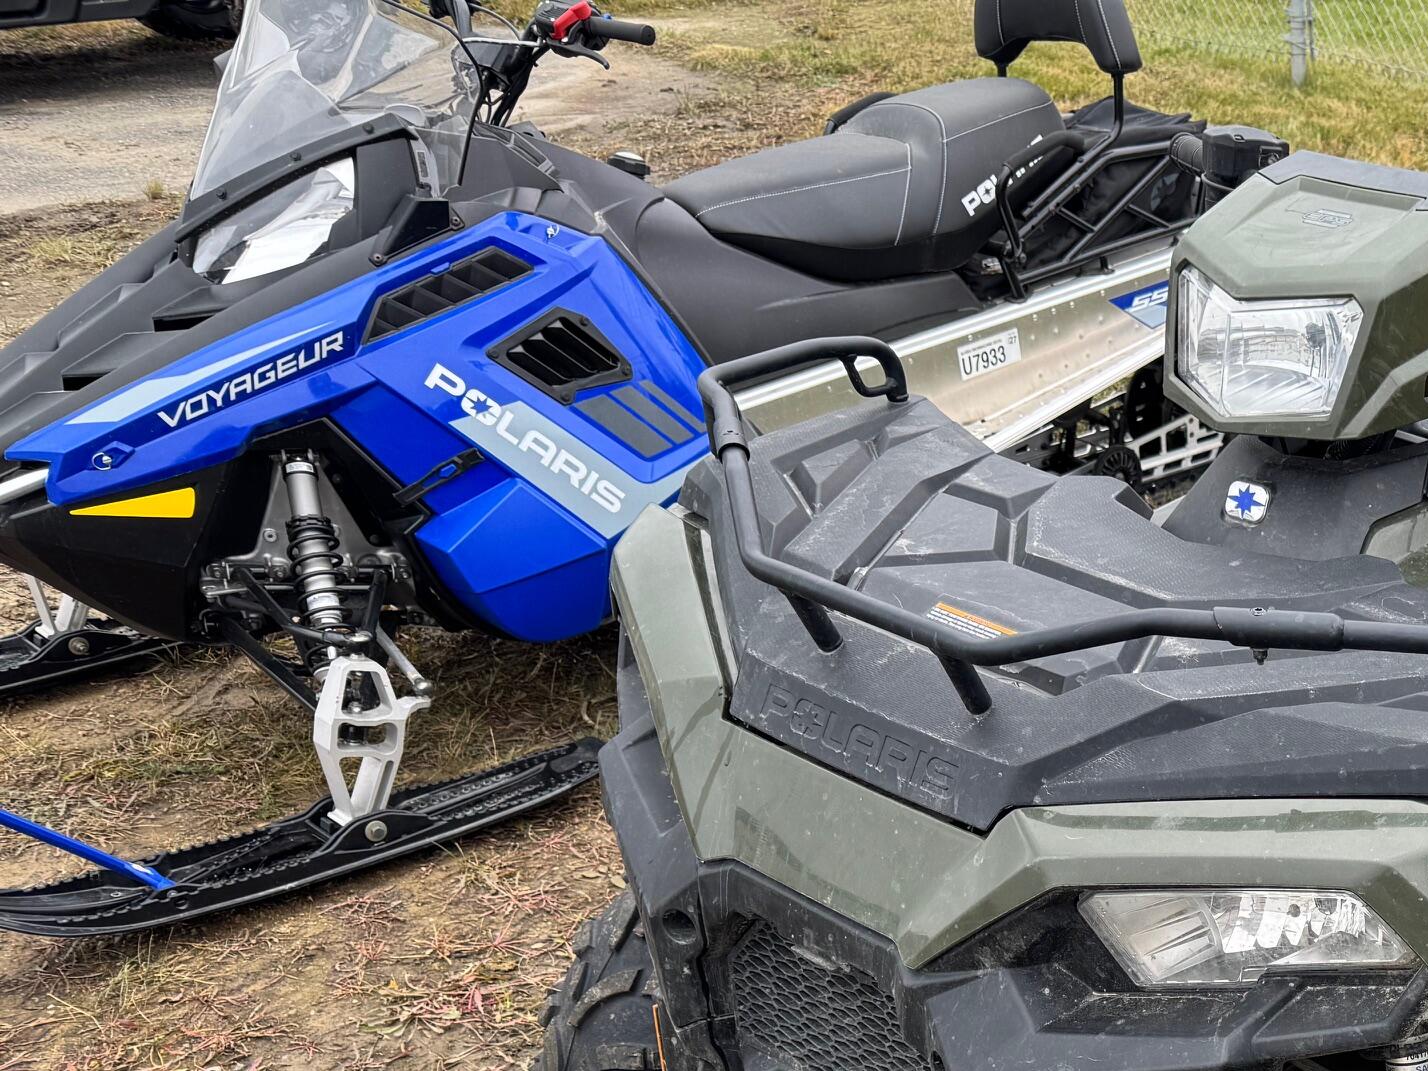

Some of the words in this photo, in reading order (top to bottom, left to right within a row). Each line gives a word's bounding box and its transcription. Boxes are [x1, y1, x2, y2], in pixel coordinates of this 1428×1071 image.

[157, 331, 343, 428] VOYAGEUR
[961, 345, 1007, 376] U7933
[424, 363, 626, 513] POLARIS
[759, 683, 960, 800] POLARIS
